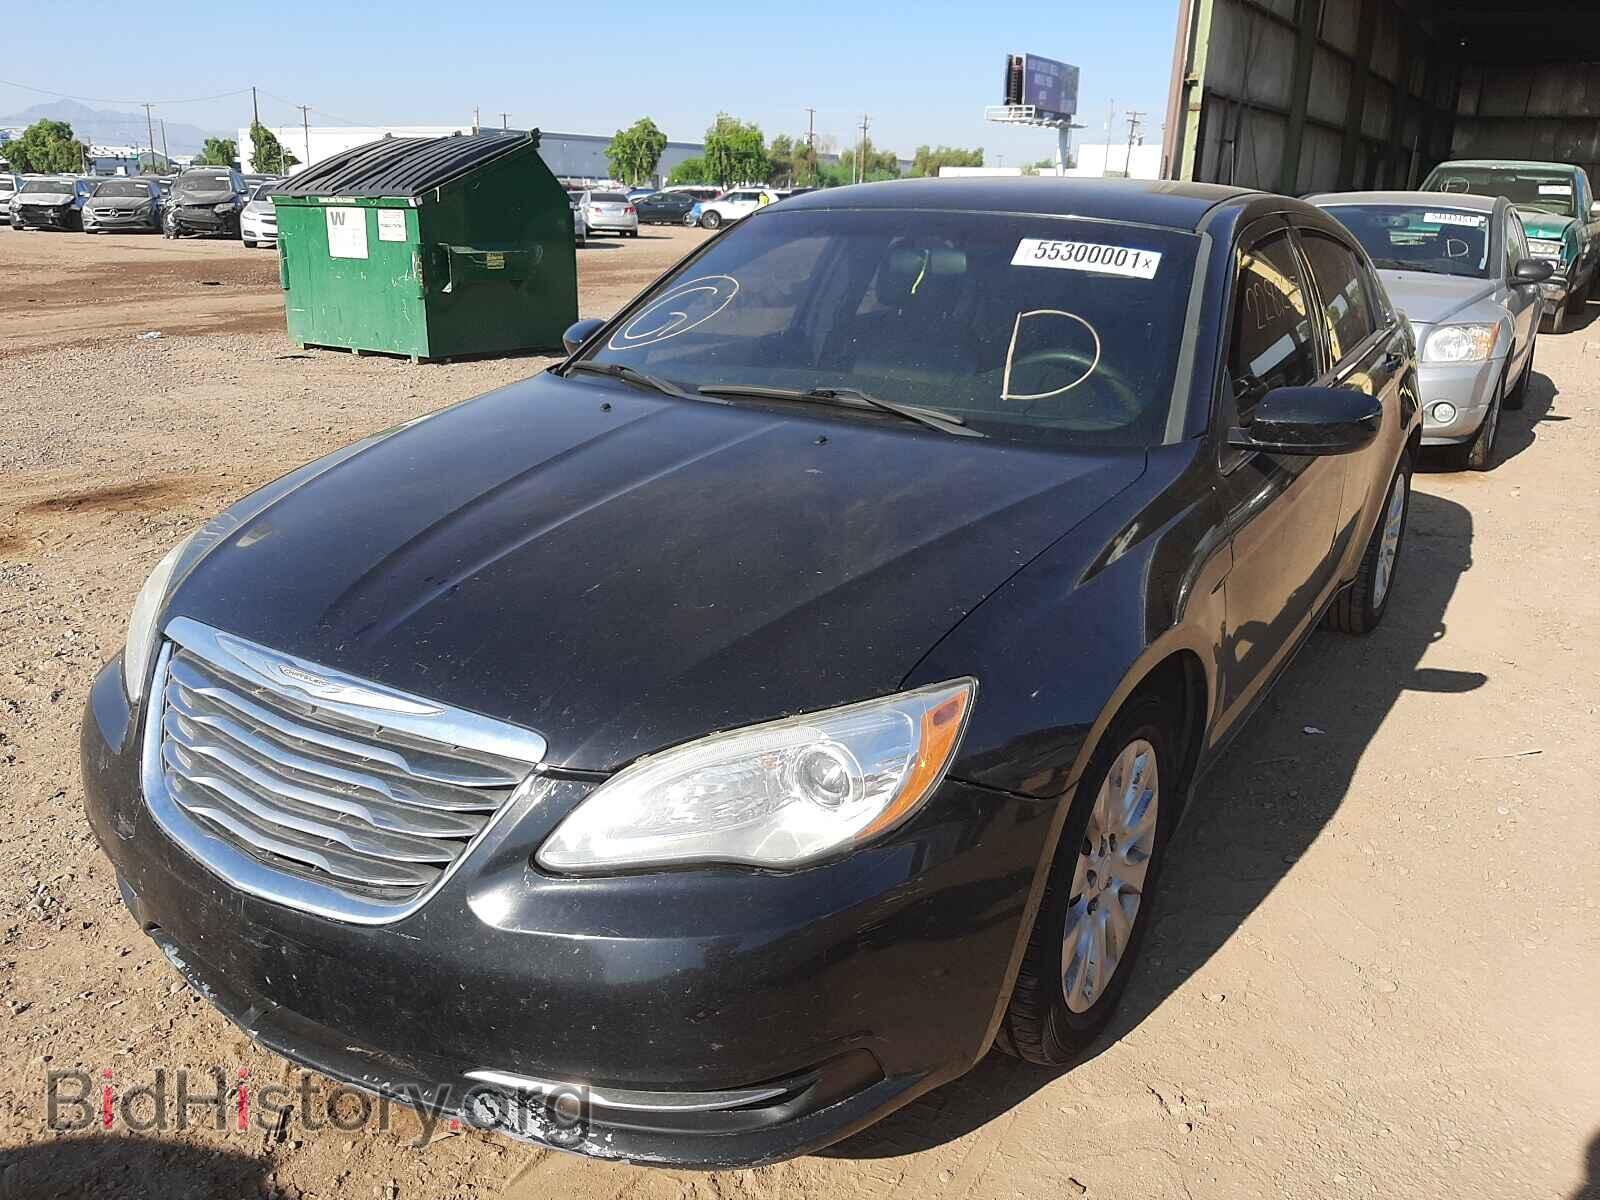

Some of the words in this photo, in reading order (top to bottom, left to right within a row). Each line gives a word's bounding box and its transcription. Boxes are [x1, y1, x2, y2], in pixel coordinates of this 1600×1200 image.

[330, 211, 346, 226] W
[1446, 238, 1469, 257] D
[1000, 309, 1101, 400] D
